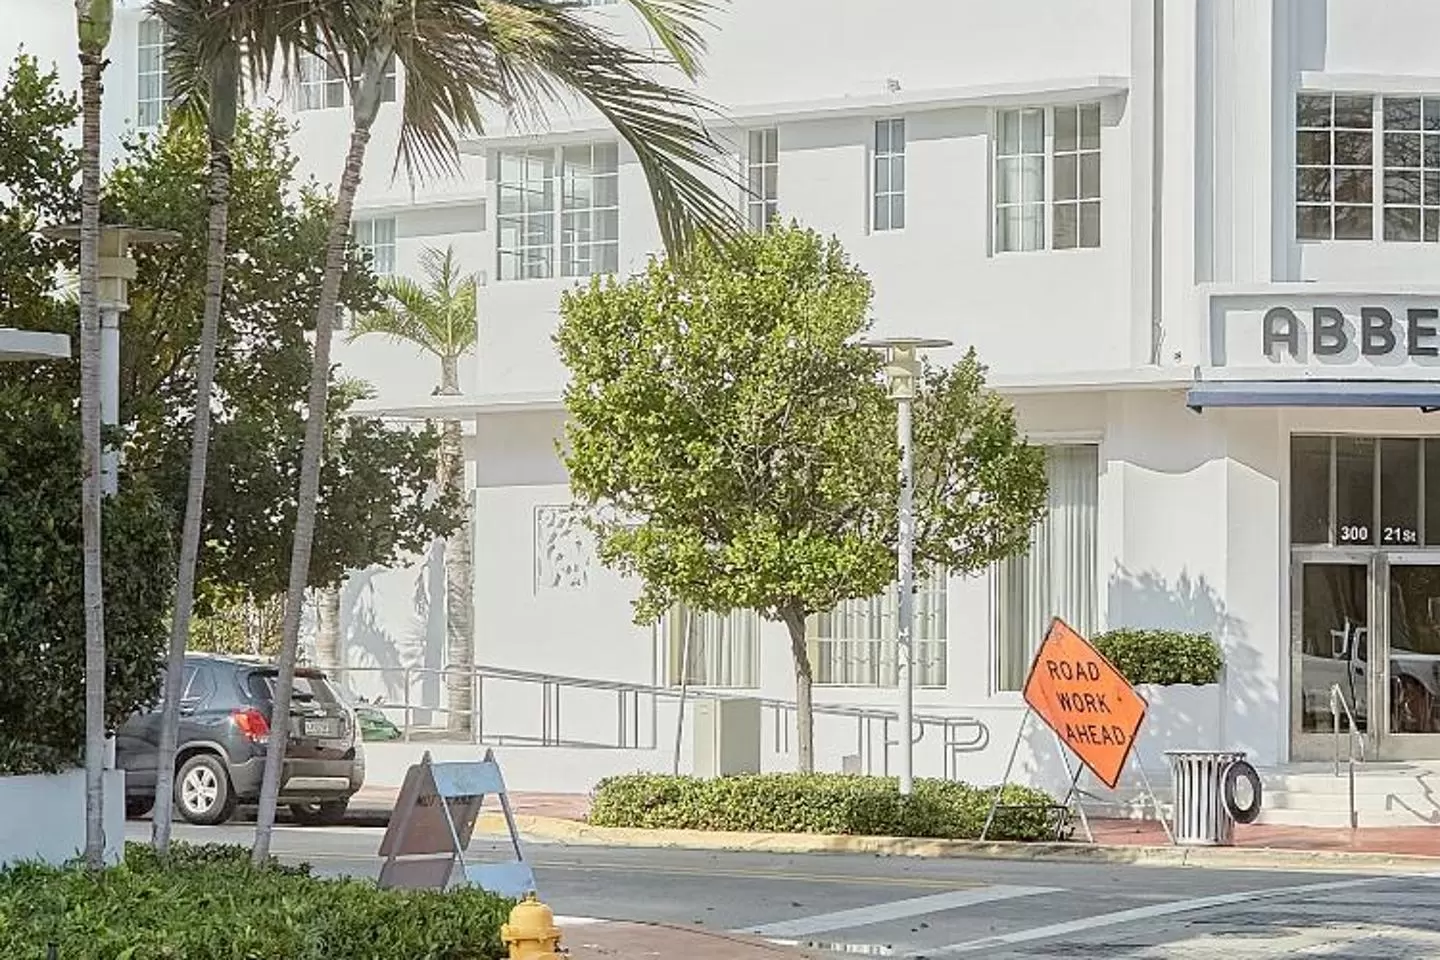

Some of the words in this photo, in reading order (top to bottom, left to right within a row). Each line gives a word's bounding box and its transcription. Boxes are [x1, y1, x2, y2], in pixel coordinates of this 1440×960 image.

[1340, 525, 1369, 541] 300
[1046, 659, 1101, 683] ROAD
[1056, 691, 1112, 714] WORK
[1065, 723, 1126, 747] AHEAD
